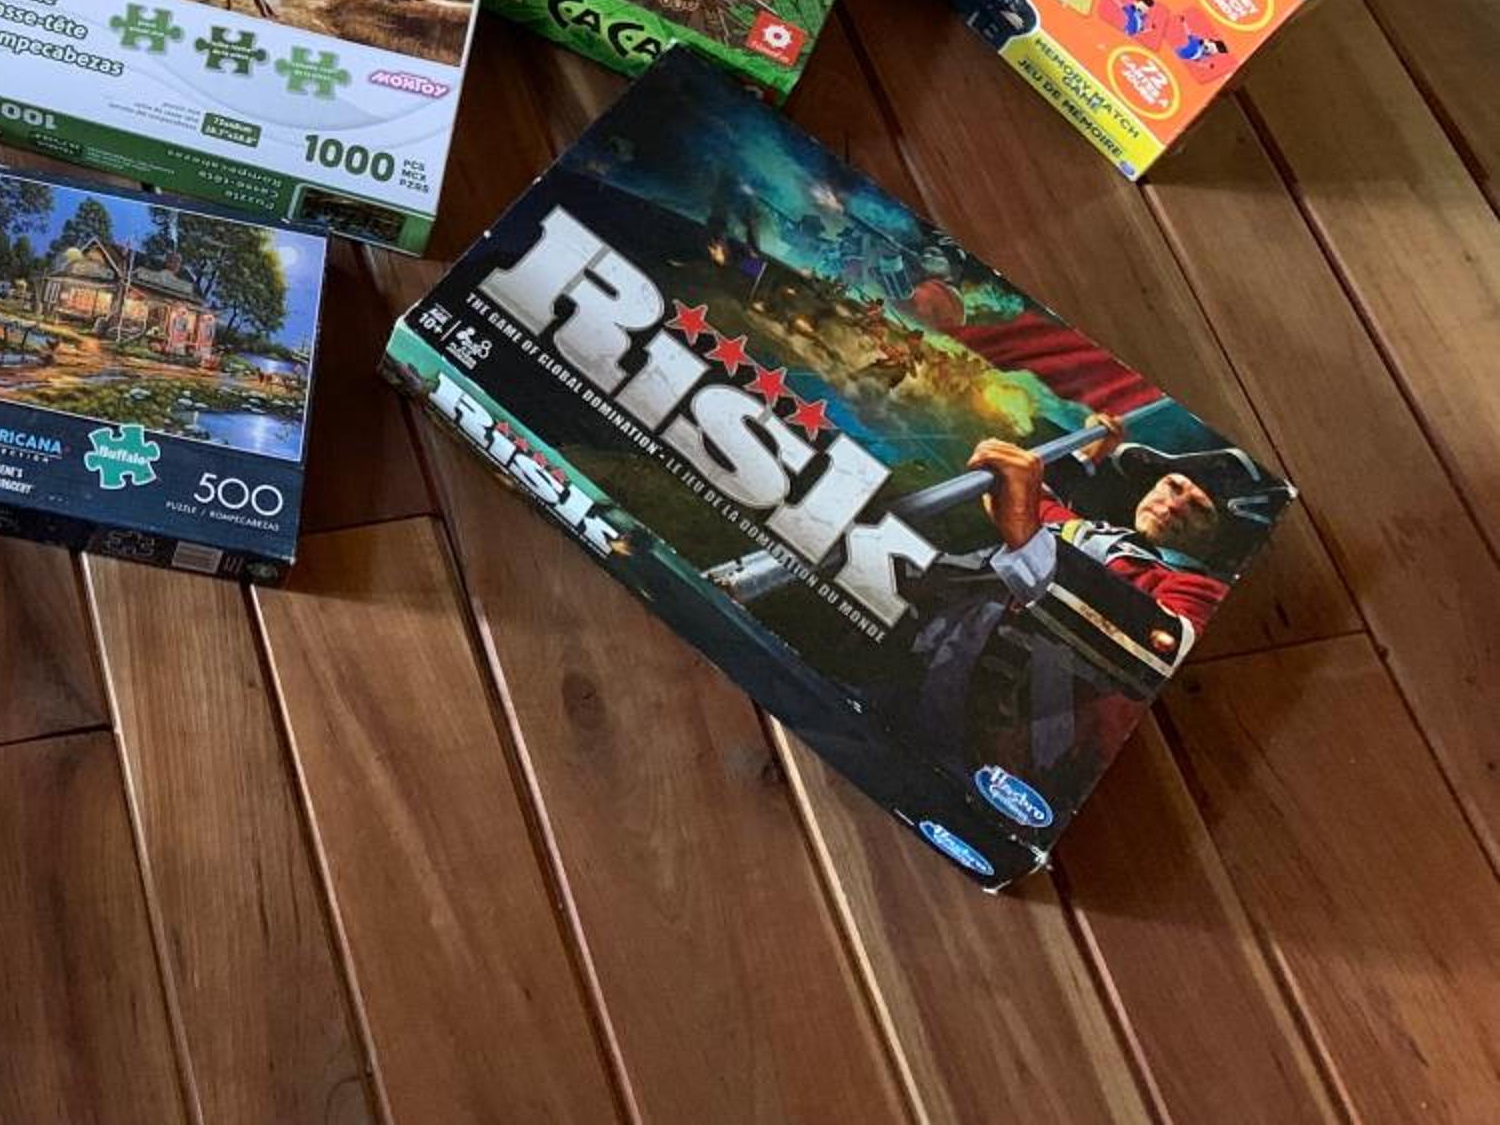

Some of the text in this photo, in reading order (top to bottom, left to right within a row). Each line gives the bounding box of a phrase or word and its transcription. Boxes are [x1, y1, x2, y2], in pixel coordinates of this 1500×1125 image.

[1018, 58, 1043, 82] JEU
[1042, 82, 1062, 100] DE
[1035, 39, 1140, 139] MEMORY MATCH
[305, 134, 395, 182] 1000
[419, 313, 443, 333] 10+
[479, 205, 941, 630] RISK
[98, 445, 146, 466] Buffalo
[429, 372, 620, 555] RISK
[466, 292, 491, 315] THE
[489, 312, 522, 348] GAME
[522, 339, 541, 356] OF
[537, 354, 581, 394] GLOBAL
[582, 389, 658, 455] DOMINATION
[666, 458, 681, 475] LE
[681, 471, 706, 494] JEU
[704, 490, 721, 508] DE
[721, 504, 739, 523] LA
[818, 582, 840, 604] DU
[839, 600, 887, 644] MONDE
[165, 500, 197, 515] PUZZLE
[209, 510, 280, 532] ROMPECABEZAS
[193, 472, 284, 516] 500
